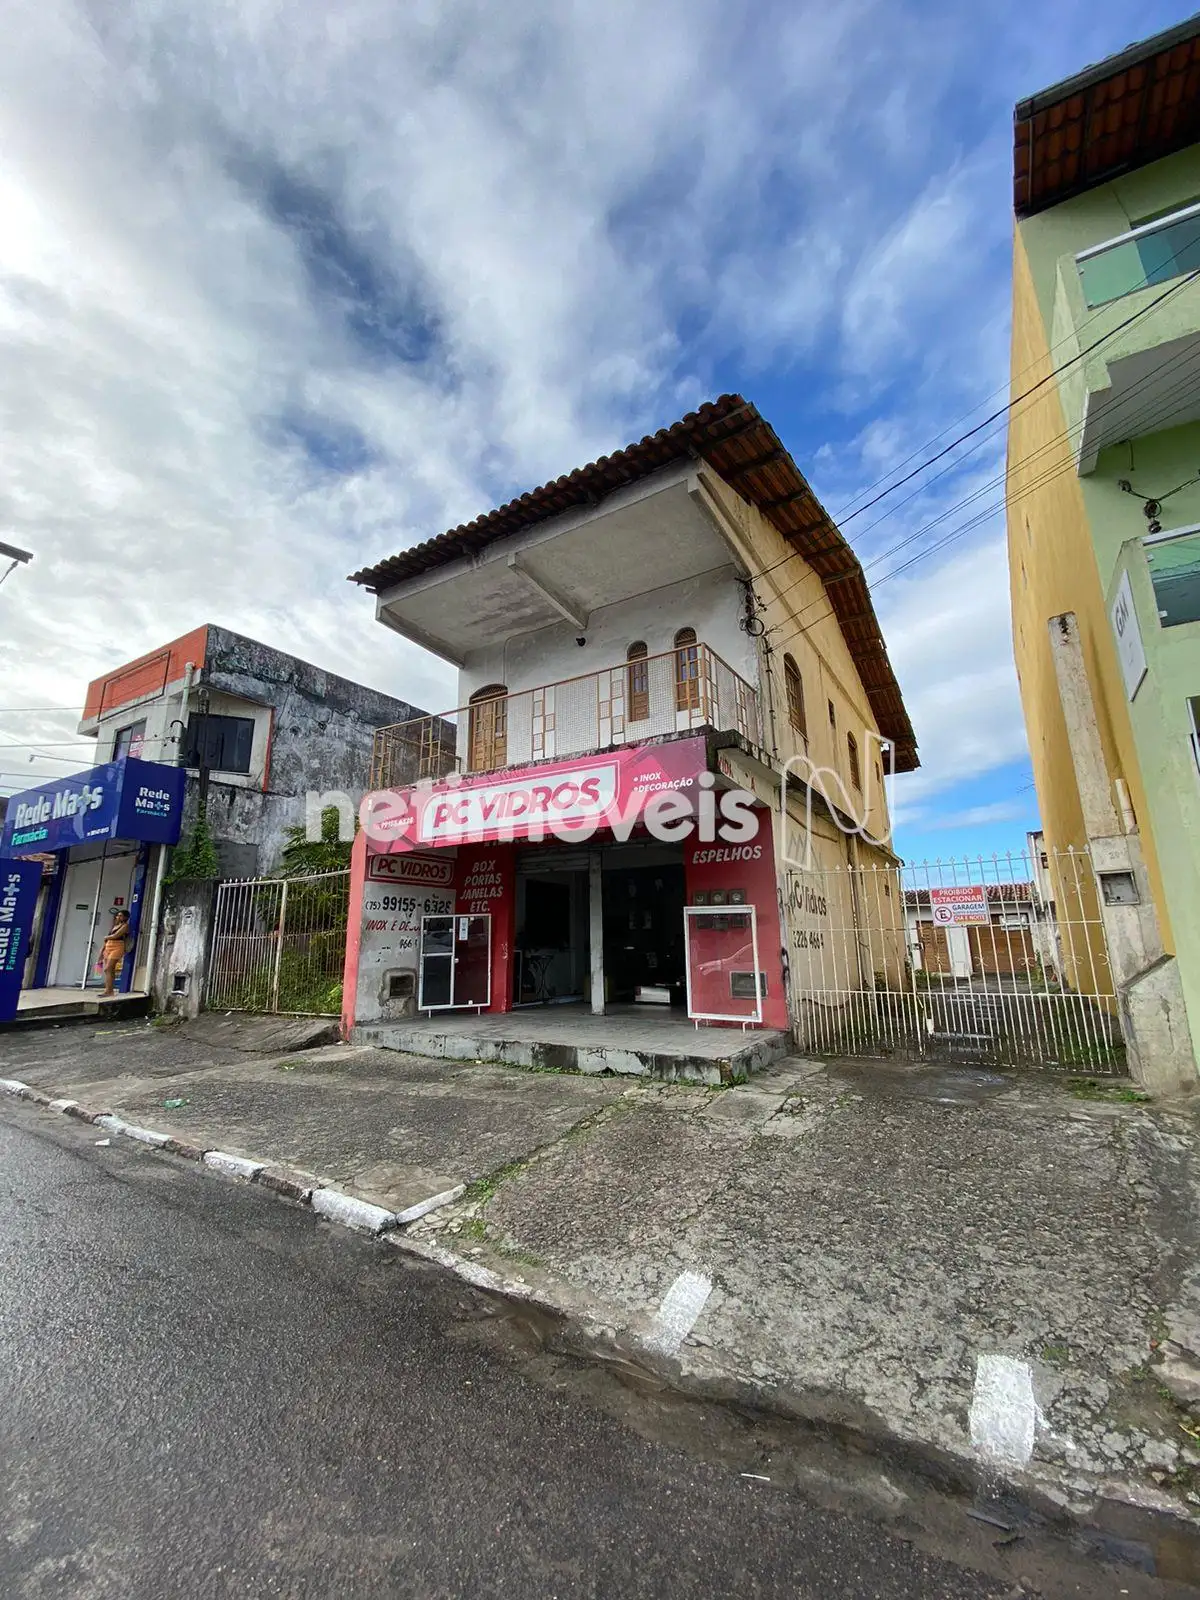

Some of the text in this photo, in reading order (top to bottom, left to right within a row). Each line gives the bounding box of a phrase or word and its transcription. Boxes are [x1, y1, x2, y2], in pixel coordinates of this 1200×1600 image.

[139, 786, 170, 800] Rede
[433, 777, 601, 828] PC VIDROS
[14, 795, 52, 830] Rede
[692, 844, 762, 865] ESPELHOS
[377, 858, 448, 879] PC VIDROS
[472, 860, 496, 873] BOX
[464, 873, 502, 887] PORTAS
[459, 886, 504, 901] JANELAS
[933, 894, 983, 904] ESTACIONAR
[938, 887, 974, 897] PROIBIDO
[469, 901, 491, 913] ETC.
[952, 903, 985, 911] GARAGEM
[365, 919, 389, 932] INOX
